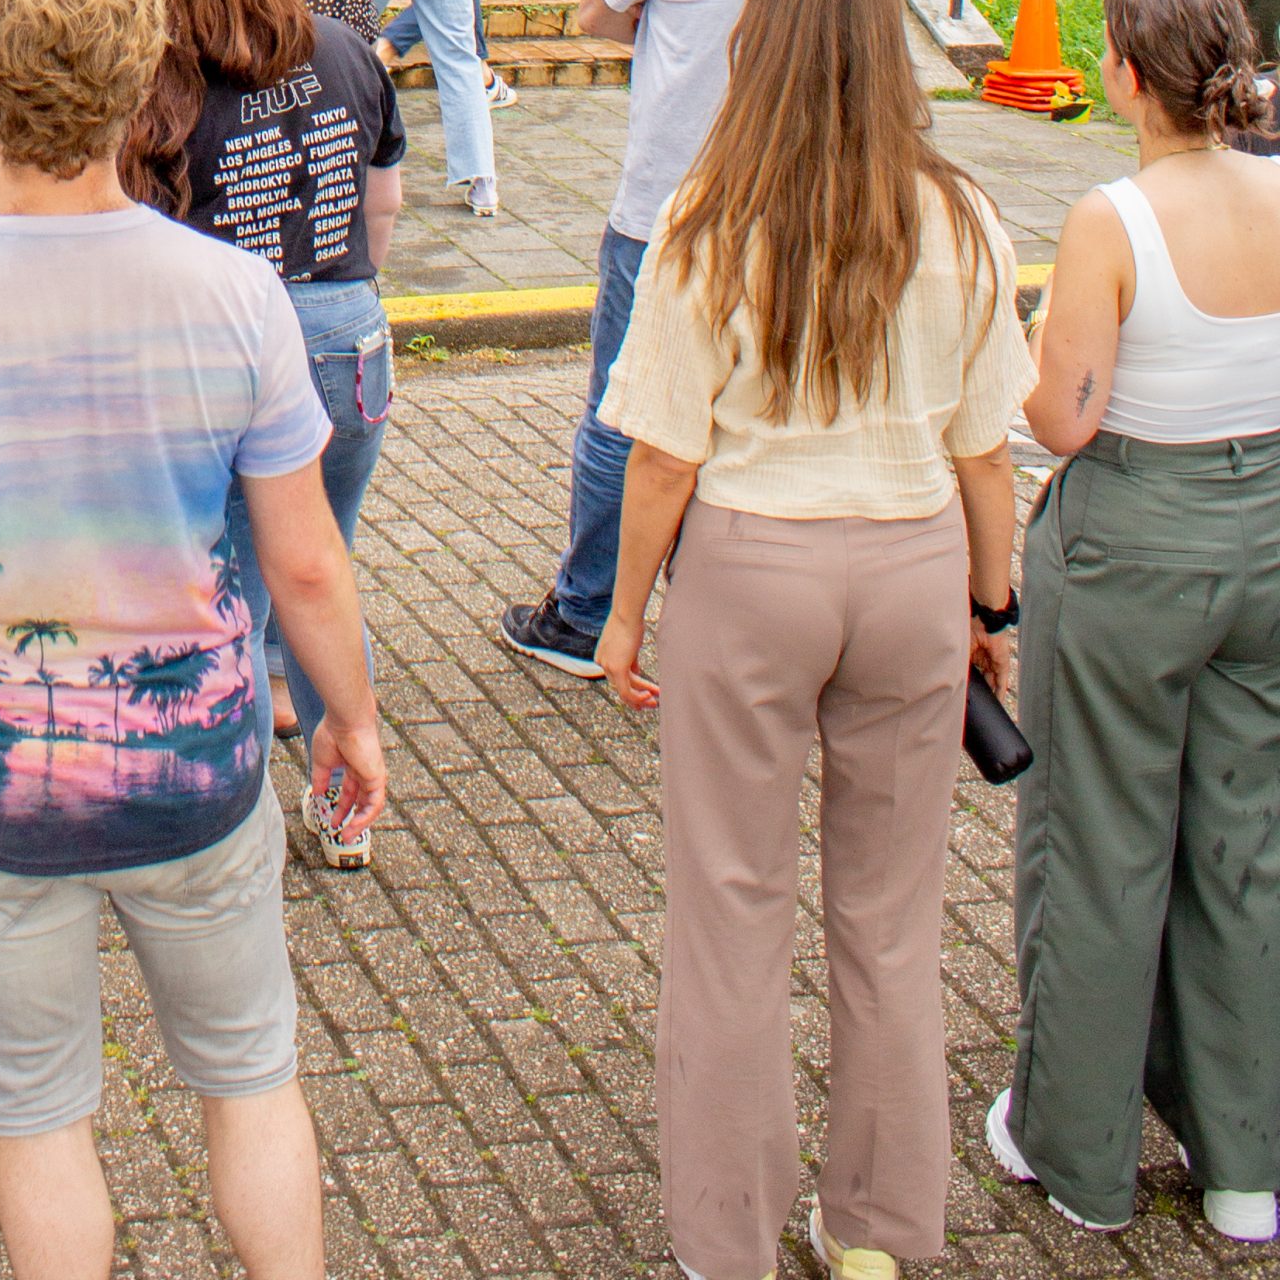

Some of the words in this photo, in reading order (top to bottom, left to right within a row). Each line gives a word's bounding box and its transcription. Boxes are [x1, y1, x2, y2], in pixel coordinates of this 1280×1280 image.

[241, 74, 322, 124] HUF
[311, 106, 347, 127] TOKYO
[225, 135, 253, 153] NEW
[254, 126, 282, 145] YORK
[301, 119, 359, 147] HIROSHIMA
[219, 154, 243, 169] LOS
[246, 139, 293, 163] ANGELES
[309, 136, 355, 160] FUKUOKA
[213, 170, 239, 186] SAN
[240, 152, 302, 179] FRANCISCO
[307, 150, 359, 176] DIVERCITY
[225, 171, 291, 196] SKIDROKYO
[314, 181, 356, 204] SHIBUYA
[227, 187, 288, 210] BROOKLYN
[213, 210, 253, 226] SANTA
[256, 197, 303, 219] MONICA
[314, 211, 352, 234] SENDAI
[236, 217, 280, 237] DALLAS
[235, 231, 281, 248] DENVER
[315, 241, 349, 262] OSAKA
